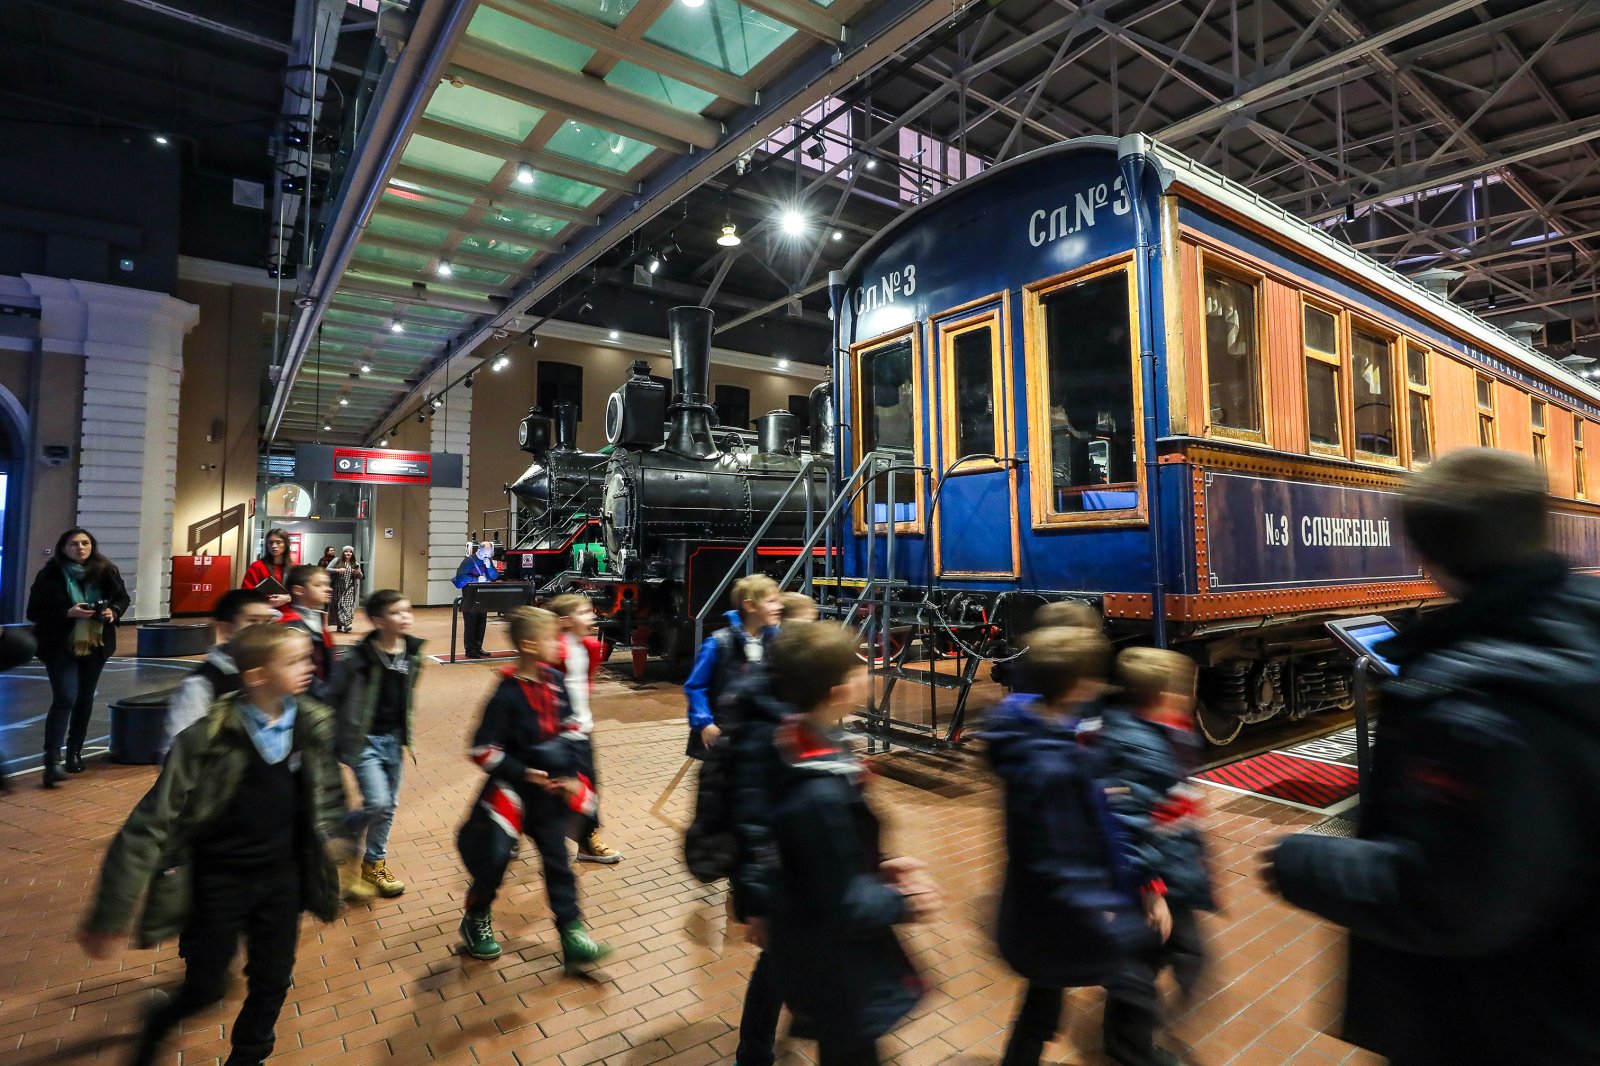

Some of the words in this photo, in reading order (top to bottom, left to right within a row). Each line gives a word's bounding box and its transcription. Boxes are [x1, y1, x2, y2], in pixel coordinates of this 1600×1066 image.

[1113, 175, 1131, 216] 3
[904, 264, 916, 297] 3
[1301, 515, 1391, 547] СЛУЖЕБНЫЙ
